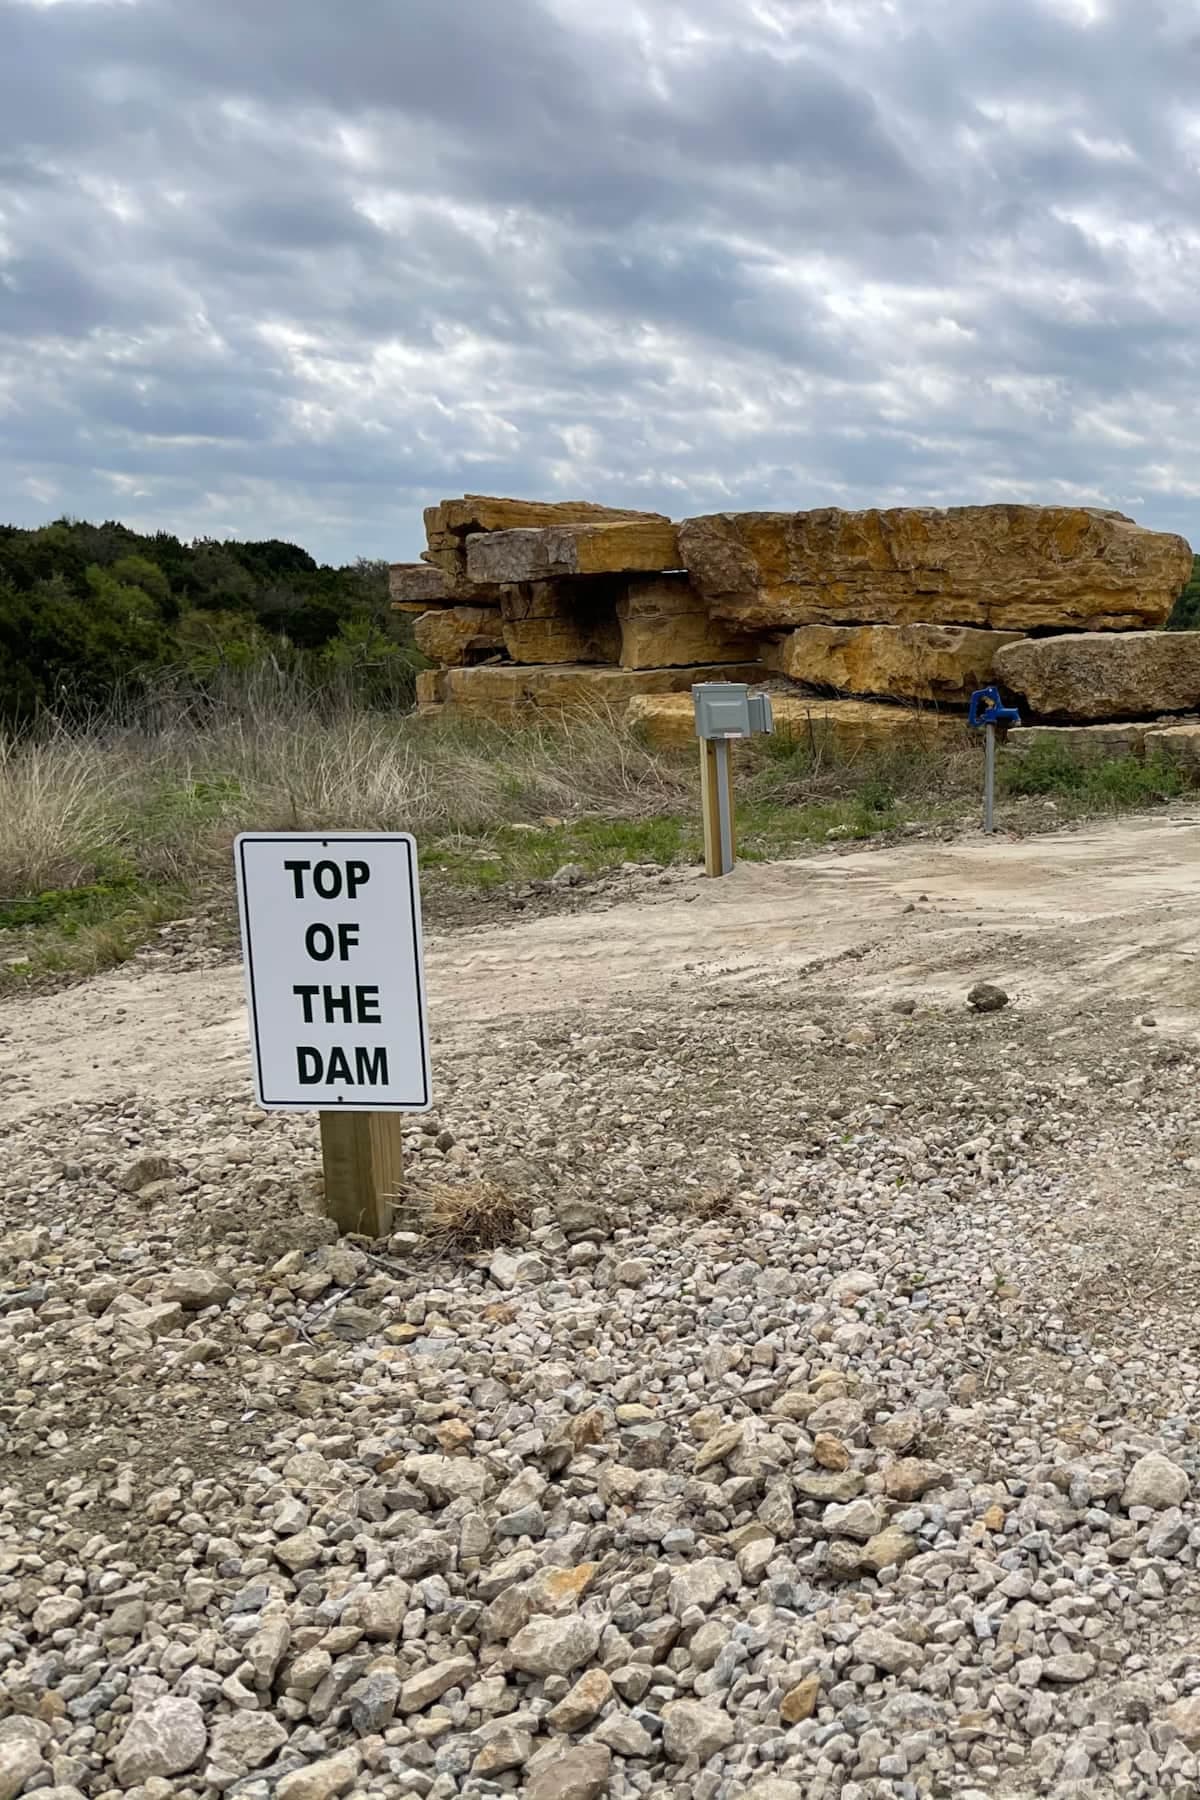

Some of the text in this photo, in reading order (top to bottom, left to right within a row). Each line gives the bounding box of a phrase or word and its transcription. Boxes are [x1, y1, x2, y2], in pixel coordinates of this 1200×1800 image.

[284, 860, 370, 899] TOP
[305, 923, 360, 961] OF
[293, 985, 381, 1024] THE
[296, 1046, 389, 1086] DAM
